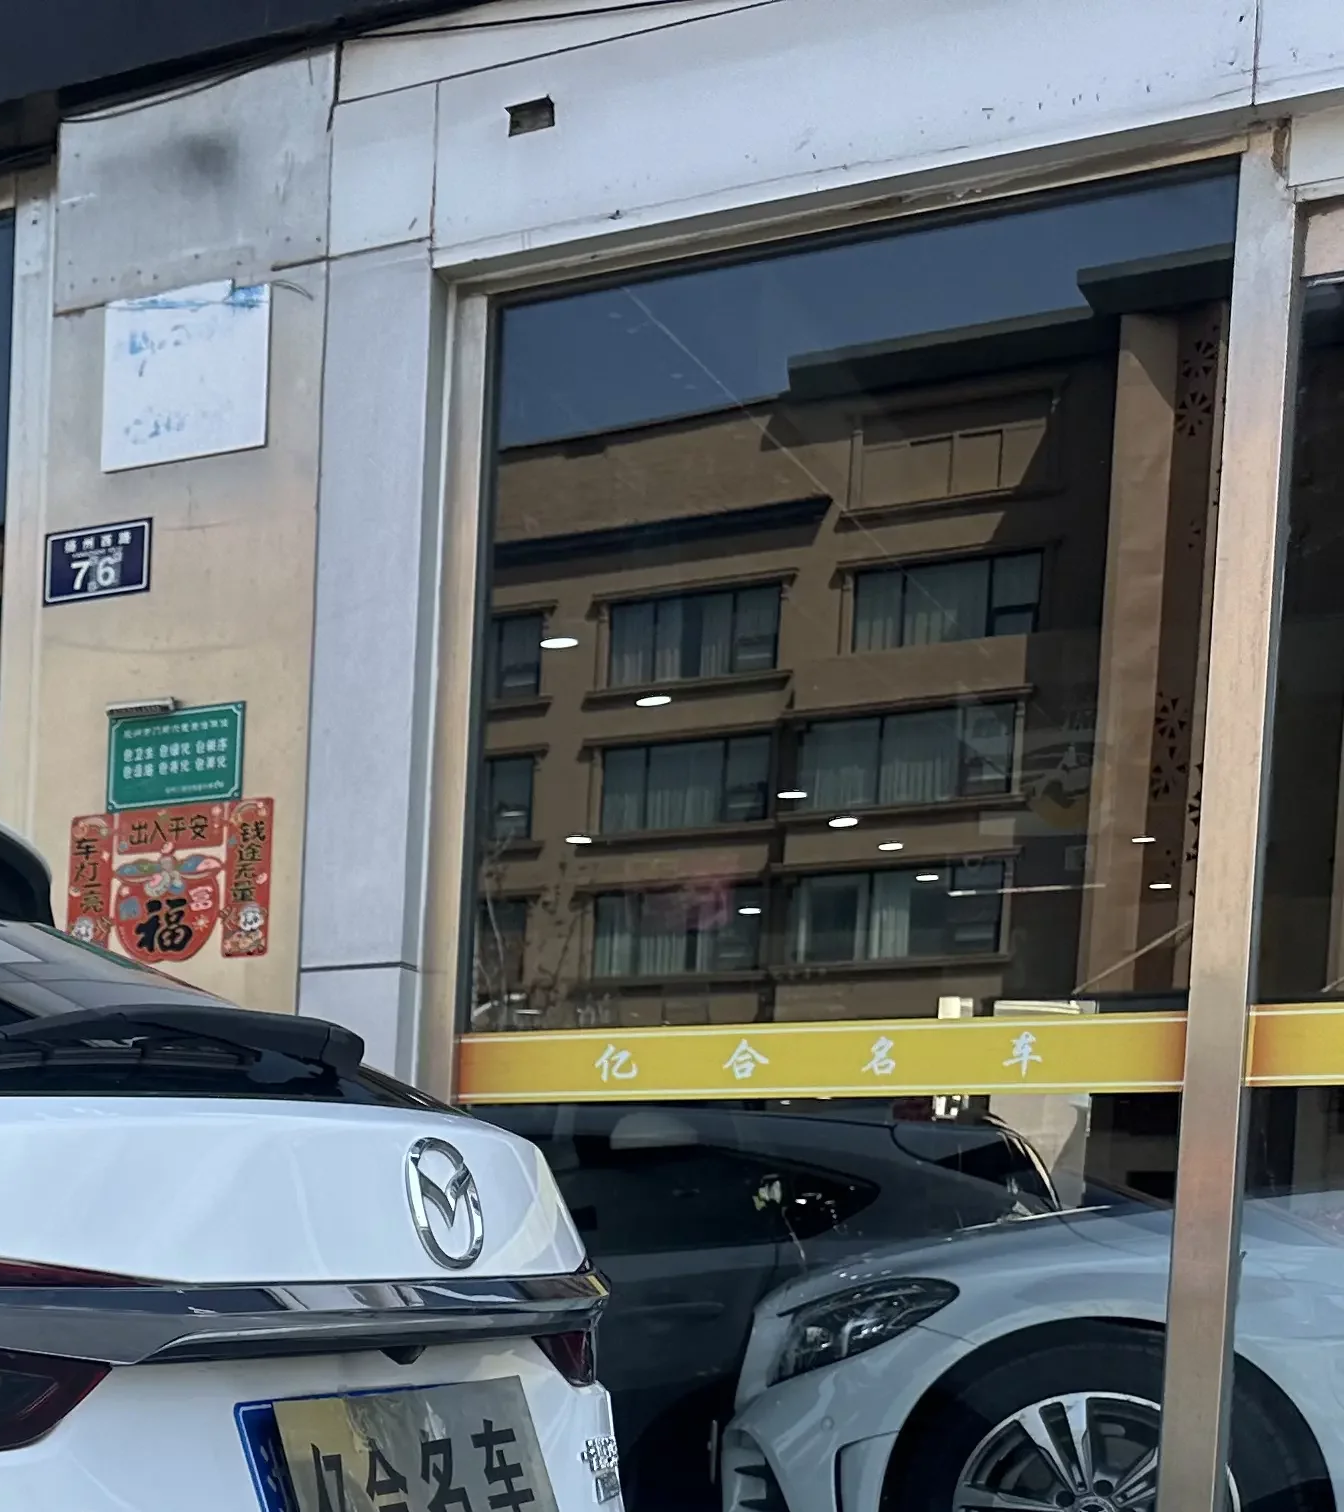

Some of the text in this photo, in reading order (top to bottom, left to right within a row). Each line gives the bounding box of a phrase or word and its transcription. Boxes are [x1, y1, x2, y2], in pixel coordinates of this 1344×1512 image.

[70, 556, 116, 590] 76
[128, 814, 209, 846] 出入平安
[135, 897, 193, 952] 福
